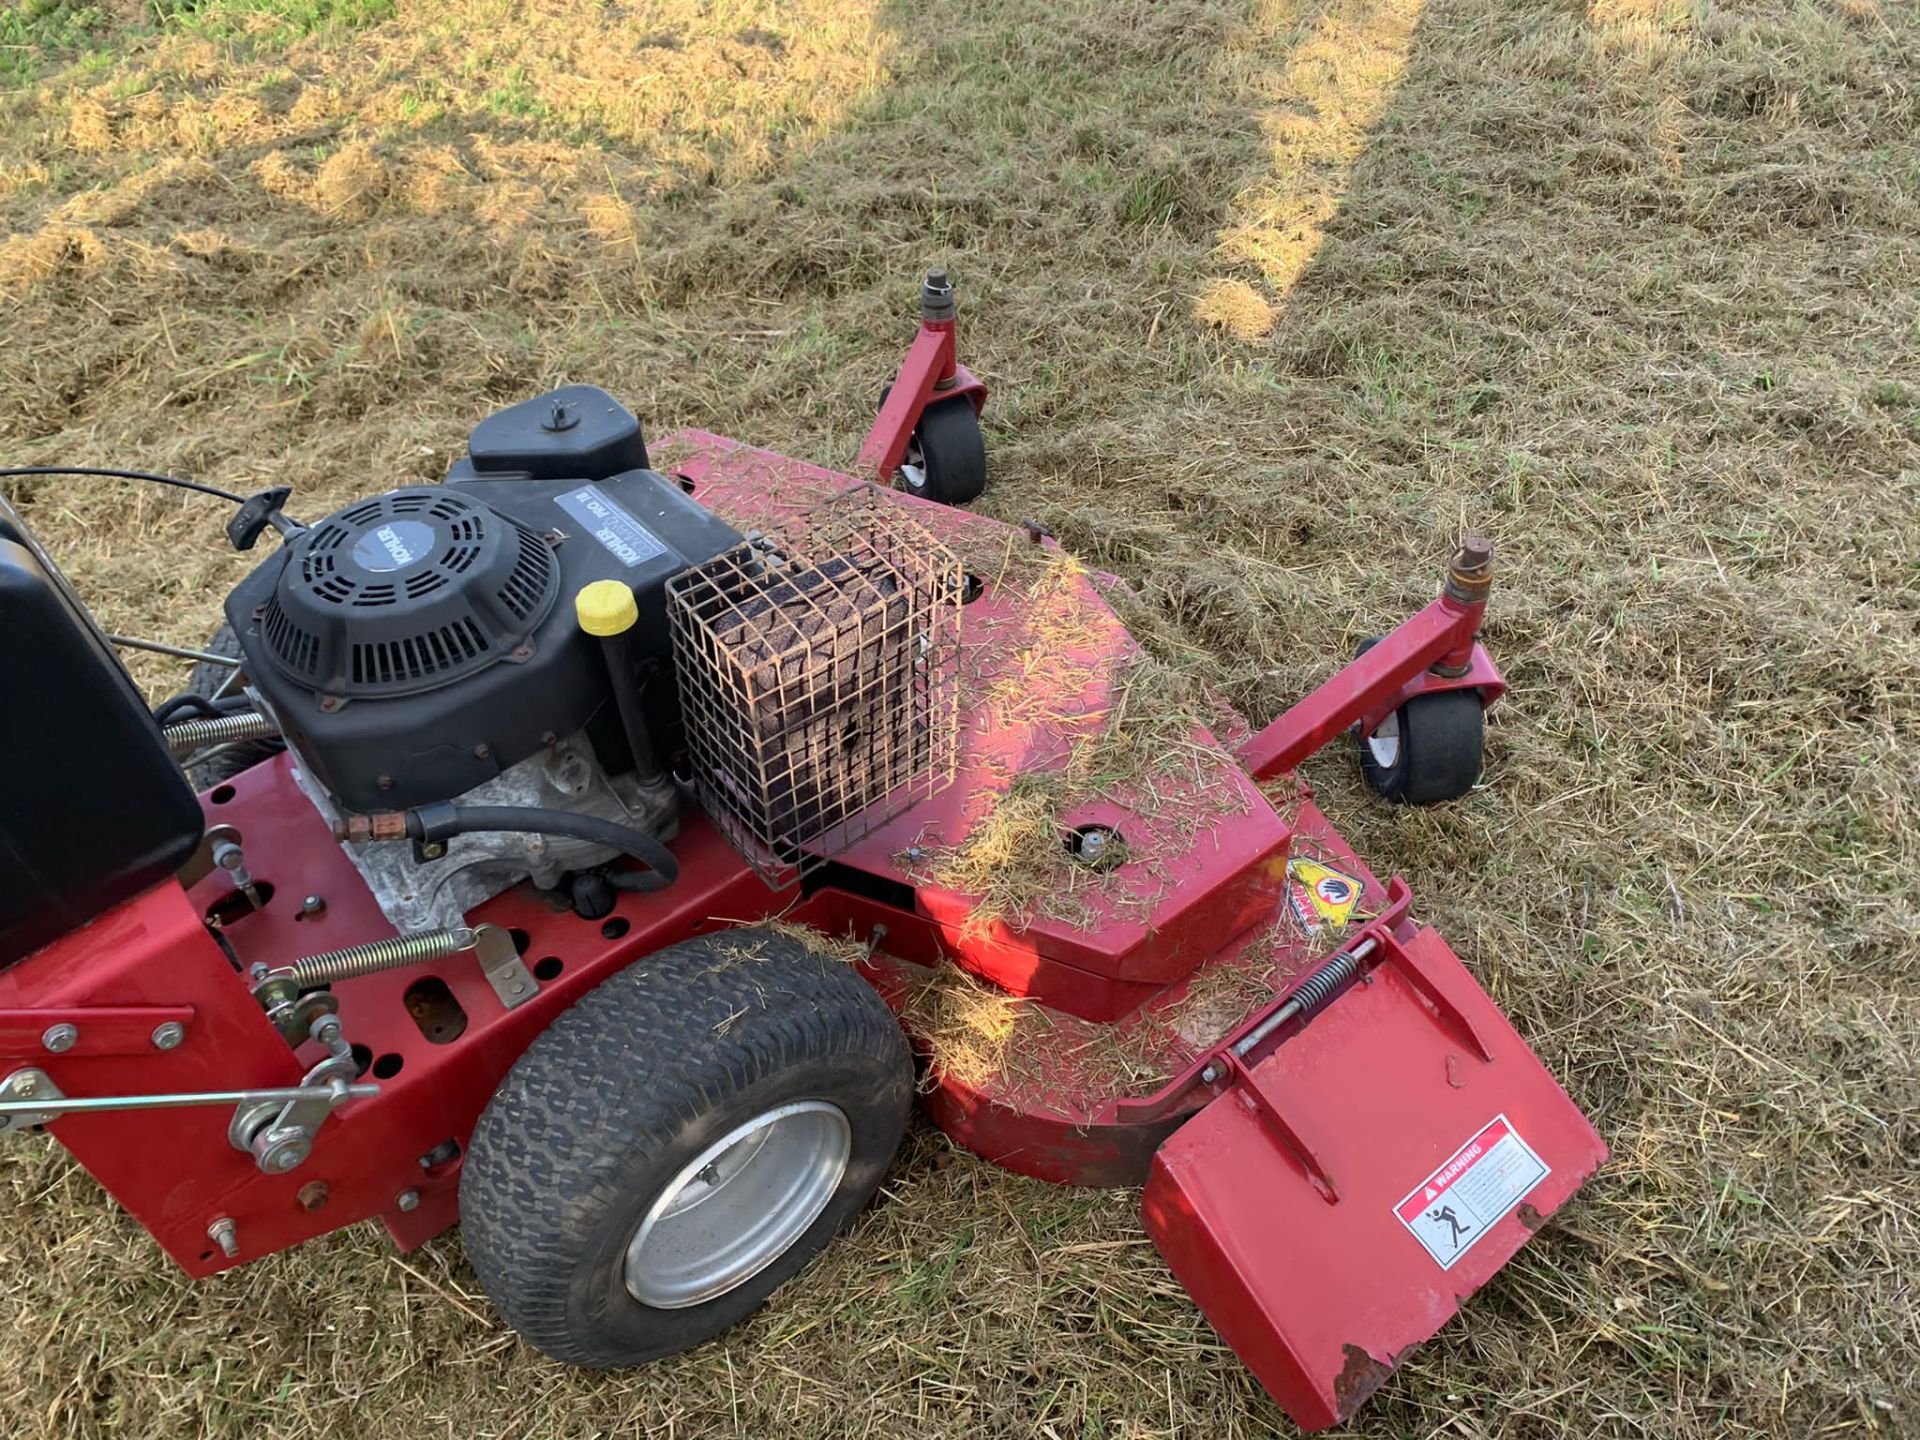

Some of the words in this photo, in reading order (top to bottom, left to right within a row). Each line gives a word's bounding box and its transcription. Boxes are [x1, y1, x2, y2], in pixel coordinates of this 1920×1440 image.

[575, 492, 592, 504] 18
[587, 501, 610, 518] PRO
[376, 524, 413, 565] KOHLER
[596, 526, 641, 564] KOHLER
[1434, 1143, 1483, 1188] WARNING
